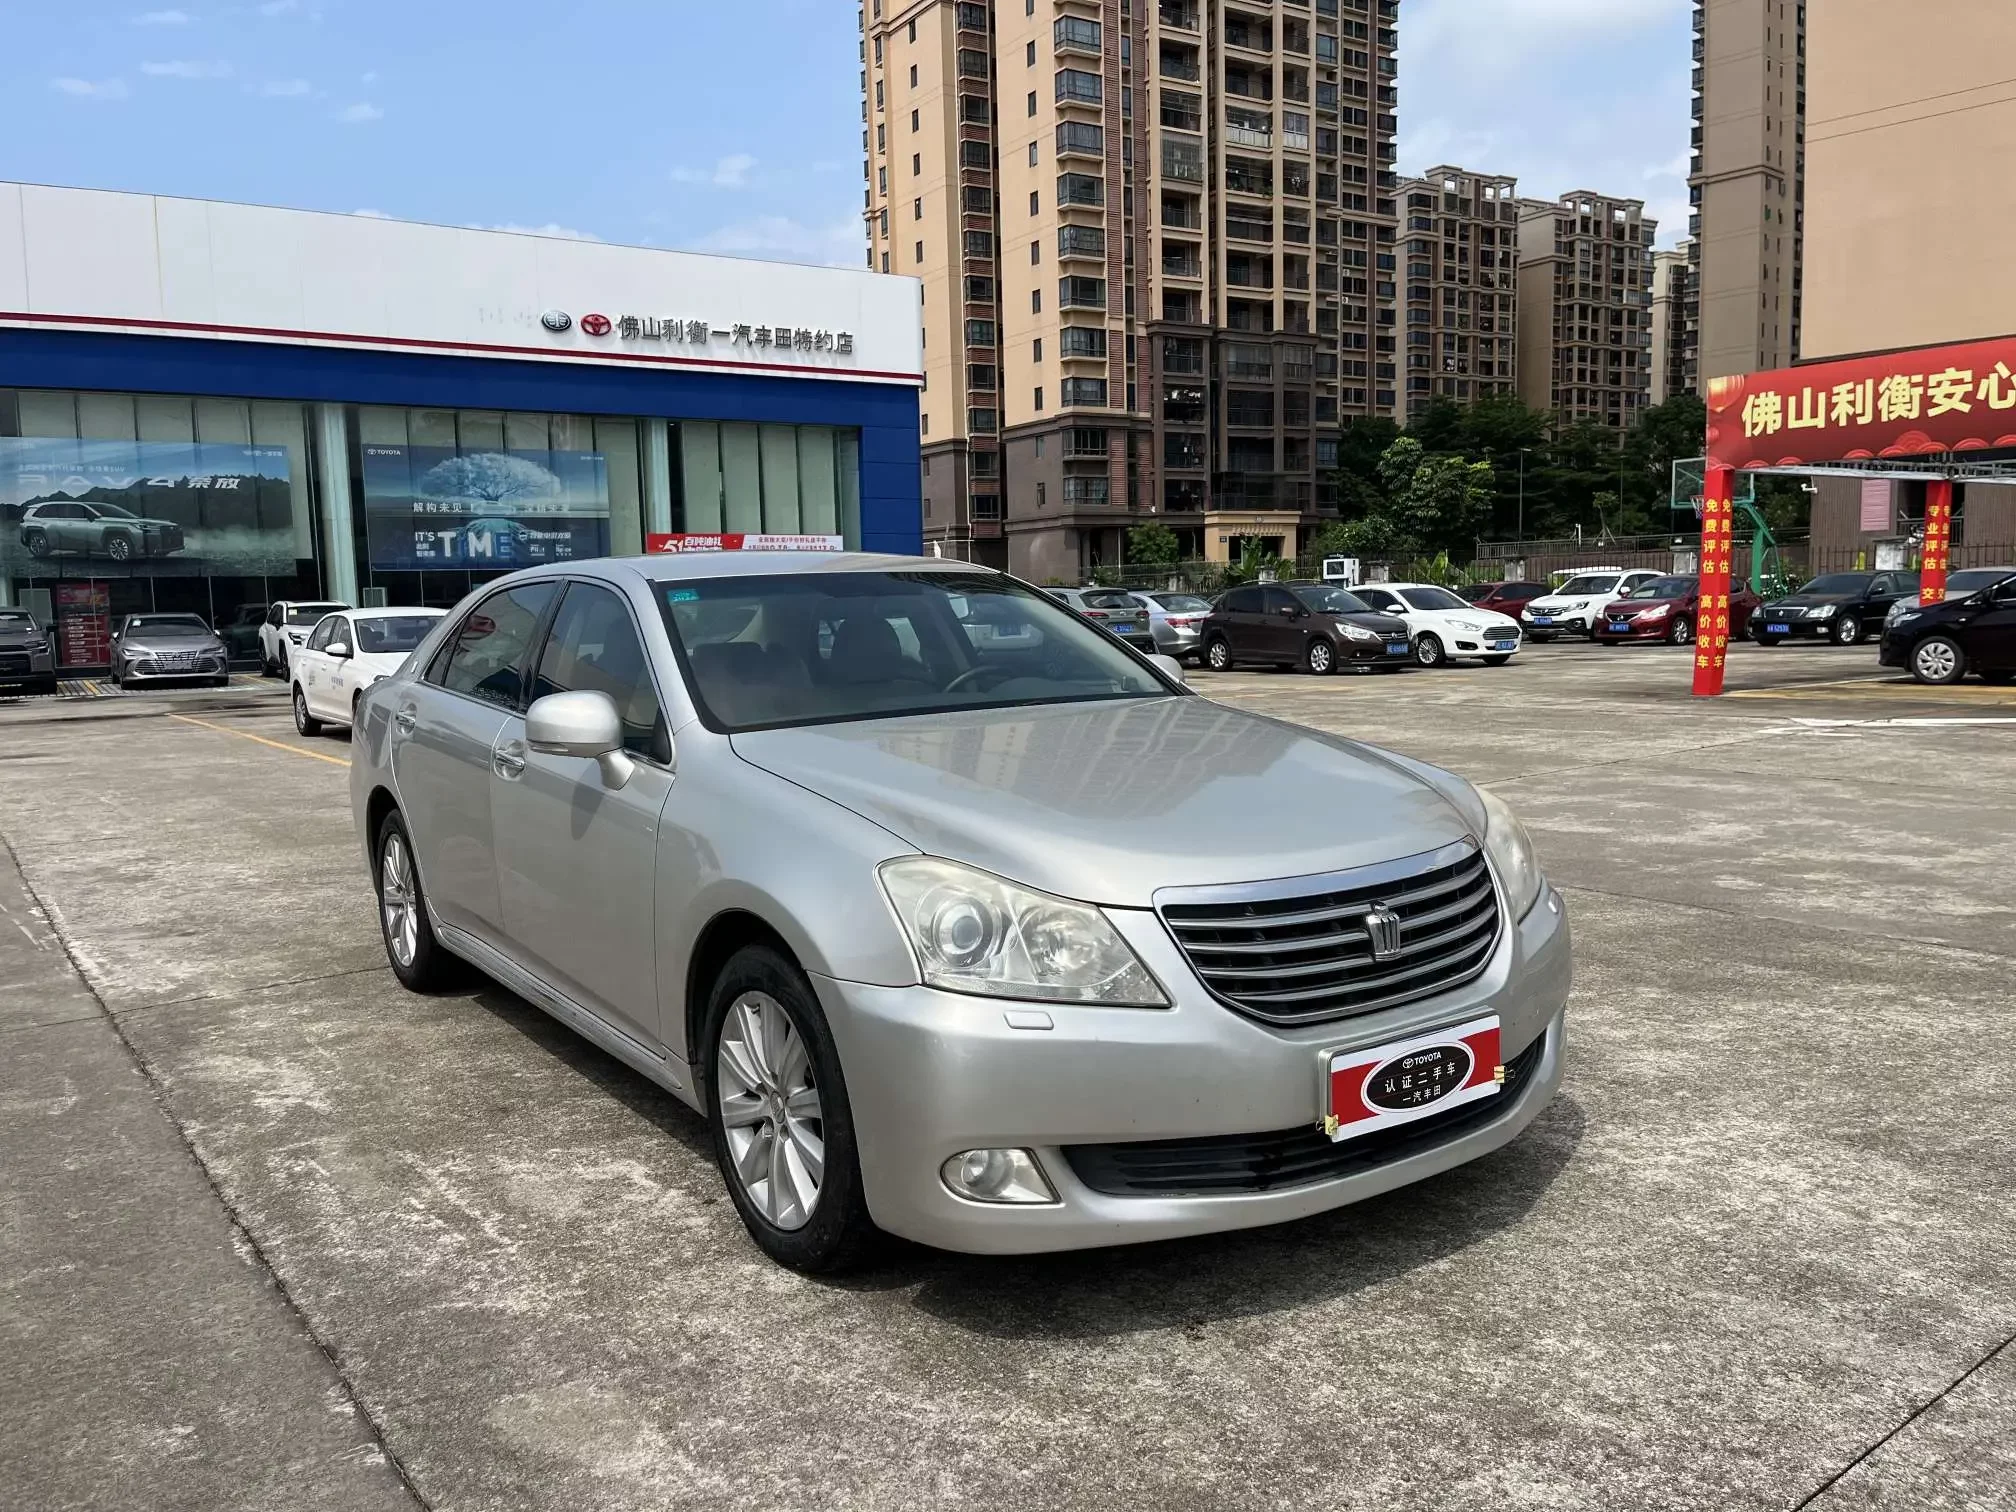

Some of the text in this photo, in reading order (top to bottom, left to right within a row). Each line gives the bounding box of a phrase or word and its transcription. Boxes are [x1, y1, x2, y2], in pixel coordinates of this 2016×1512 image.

[618, 314, 853, 355] 佛山利衡一汽丰田特约店
[1741, 361, 2016, 437] 佛山利衡安心
[415, 531, 435, 541] IT'S
[1923, 505, 1940, 570] 专业评估
[1696, 498, 1718, 668] 免费评估 高价收车
[1713, 498, 1732, 667] 免费评估 高价收车
[1384, 1061, 1456, 1093] 认证二手车
[1414, 1051, 1442, 1066] TOYOTA
[1402, 1084, 1441, 1102] 一汽丰田
